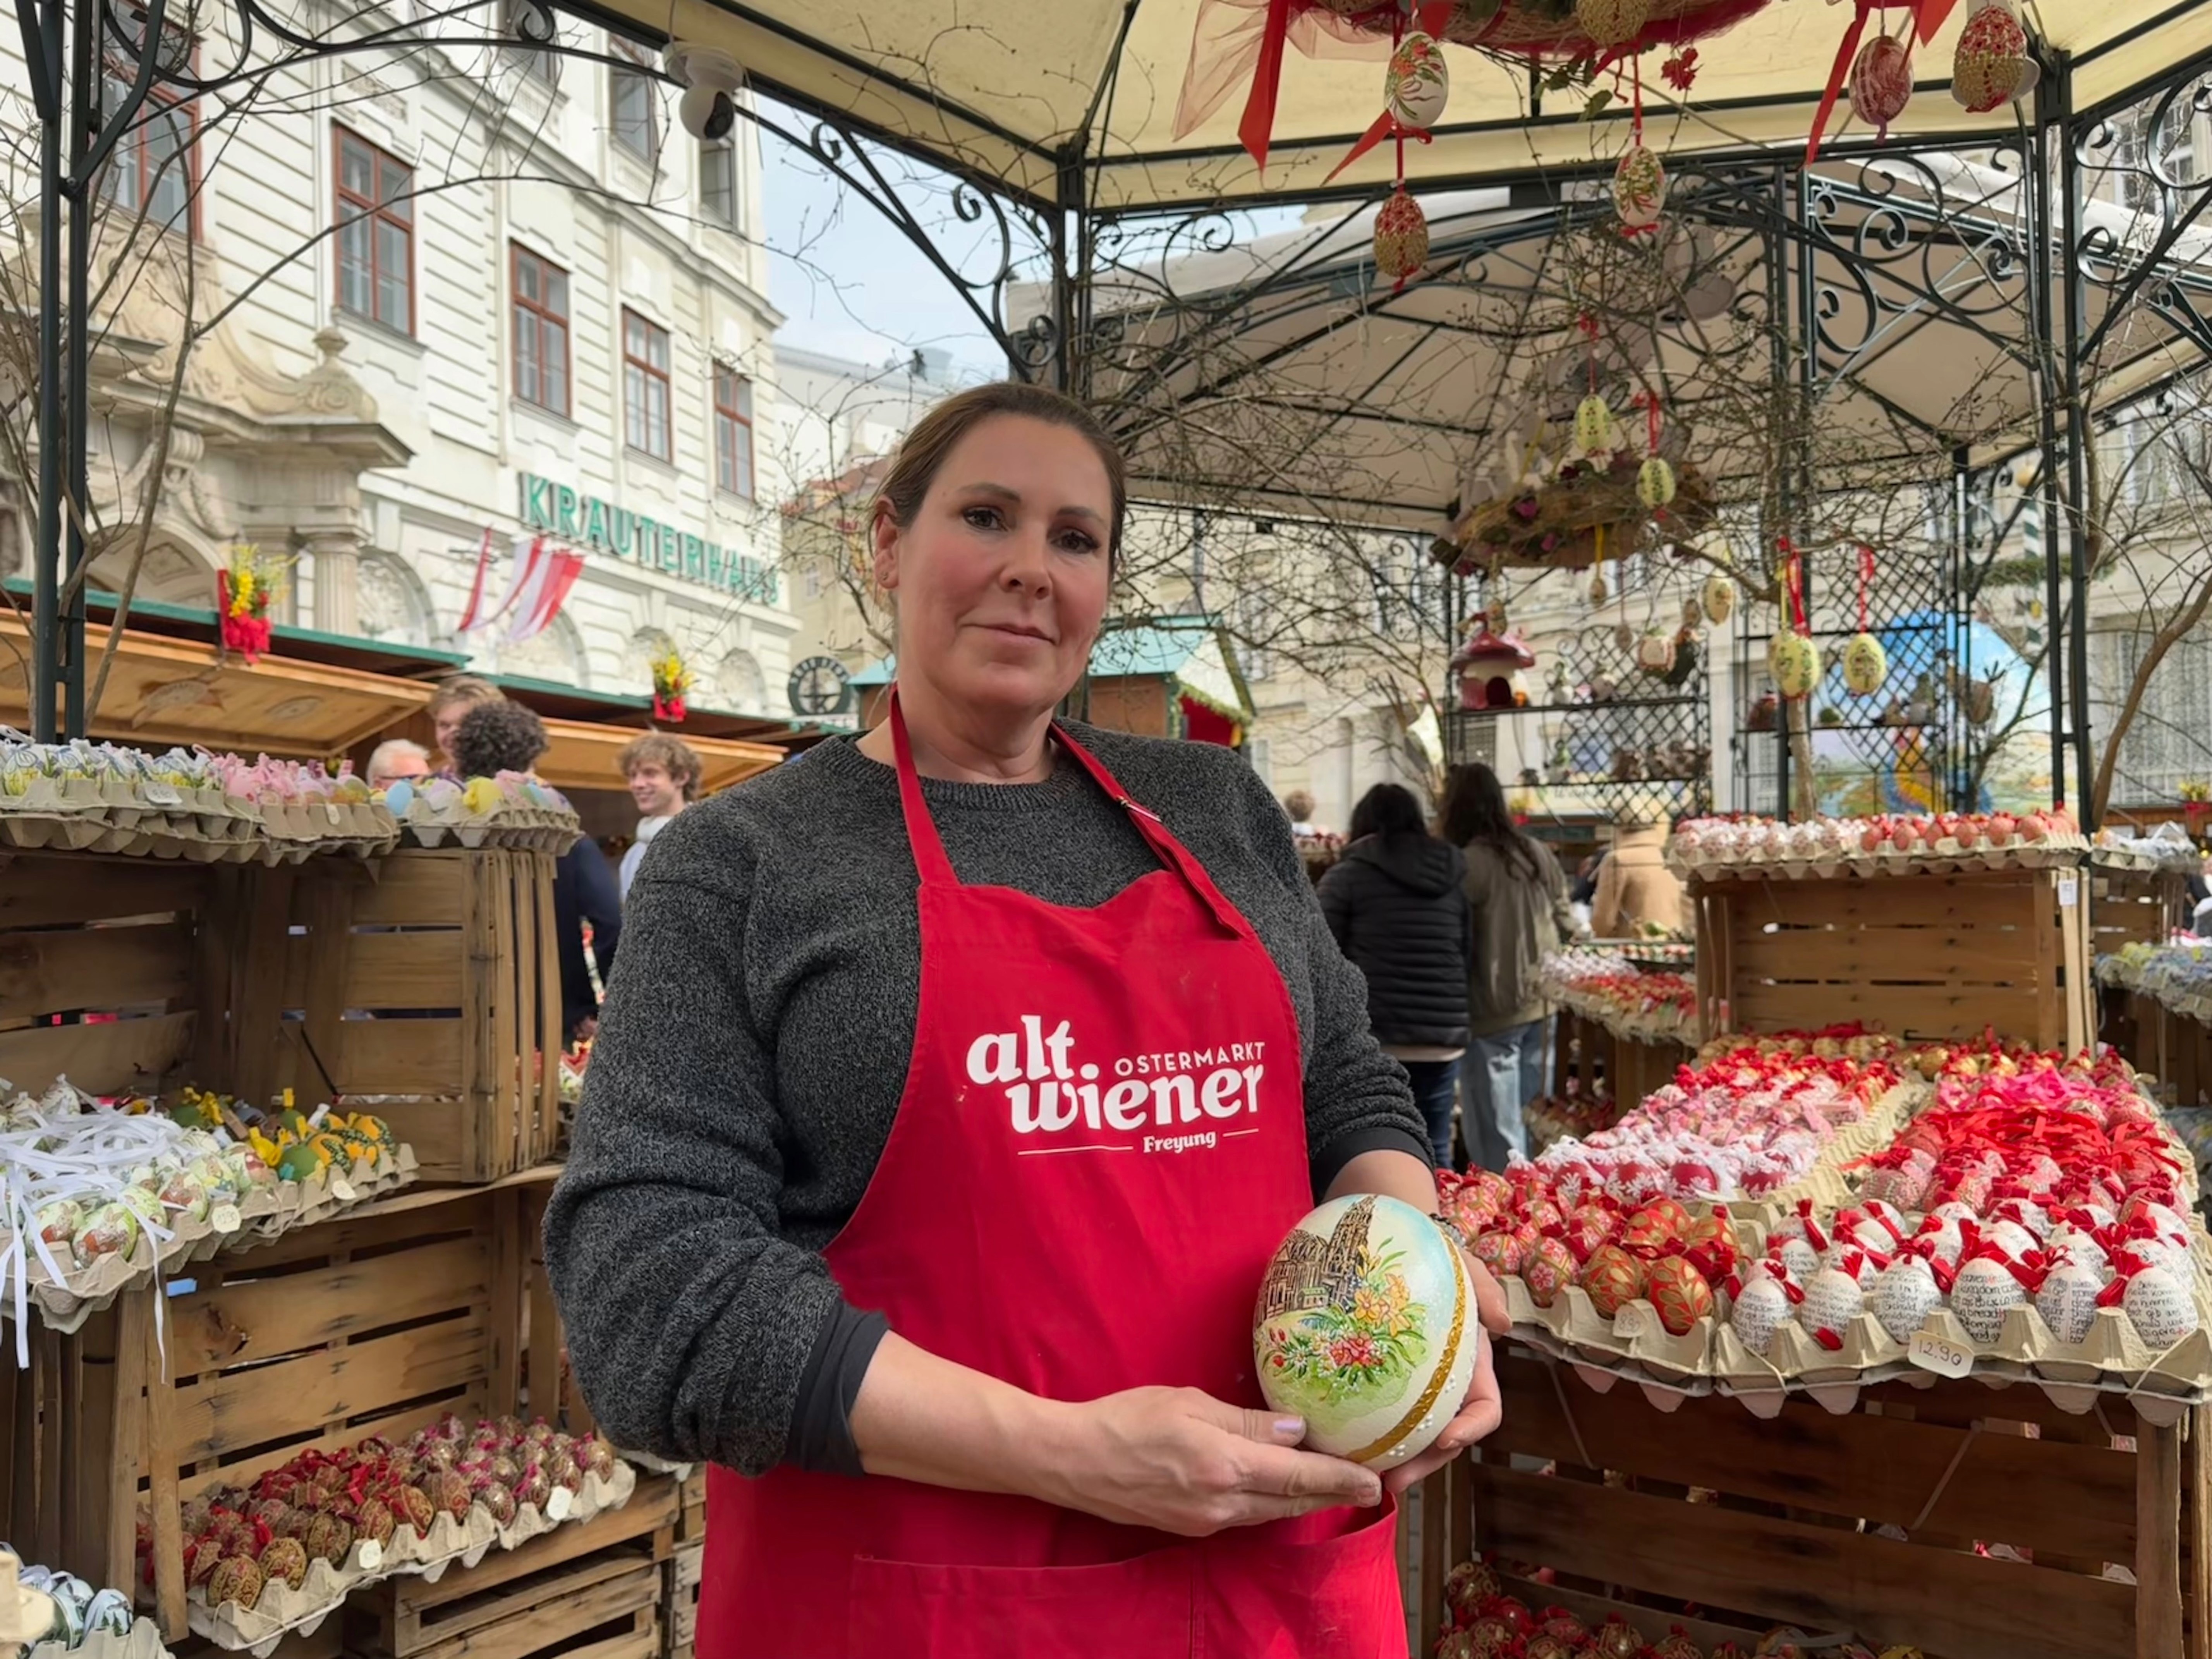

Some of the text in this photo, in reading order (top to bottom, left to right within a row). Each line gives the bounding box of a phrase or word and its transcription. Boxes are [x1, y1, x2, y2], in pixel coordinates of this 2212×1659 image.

[966, 1015, 1075, 1084] alt
[1115, 1042, 1266, 1077] OSTERMARKT
[1005, 1063, 1264, 1133] wiener
[1143, 1130, 1216, 1154] Freyung
[1919, 1339, 1962, 1366] 12.90
